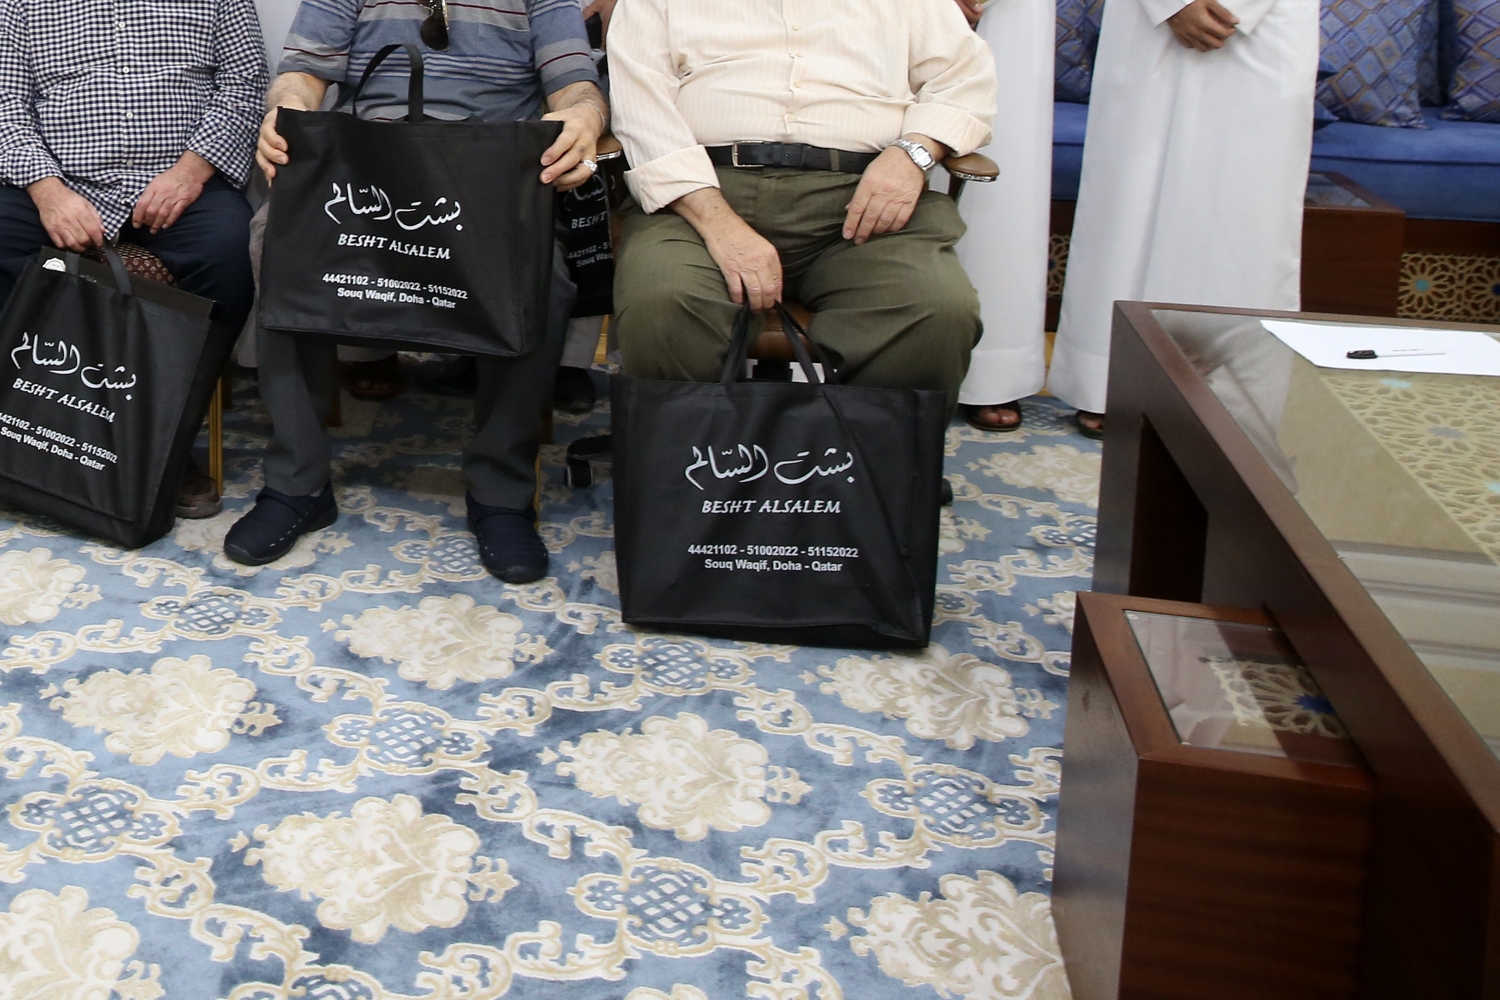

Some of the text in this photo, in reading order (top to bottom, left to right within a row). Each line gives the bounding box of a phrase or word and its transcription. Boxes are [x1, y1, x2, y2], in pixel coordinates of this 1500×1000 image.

[394, 197, 463, 231] بشت
[337, 233, 451, 260] BESHT ALSALEM
[322, 273, 369, 286] 44421102
[376, 277, 421, 291] 51002022
[428, 284, 469, 300] 51152022
[337, 288, 363, 300] Souq
[398, 293, 425, 304] Doha
[431, 297, 456, 309] Qatar
[81, 363, 137, 401] بشت
[12, 378, 116, 423] BESHT ALSALEM
[0, 427, 22, 443] Souq
[51, 445, 74, 460] Doha
[79, 455, 105, 471] Qatar
[35, 426, 76, 447] 51002022
[81, 443, 118, 464] 51152022
[773, 447, 855, 485] بشت
[701, 500, 842, 514] BESHT ALSALEM
[687, 544, 737, 556] 44421102
[746, 545, 798, 557] 51002022
[807, 546, 859, 558] 51152022
[704, 559, 733, 571] Souq
[735, 559, 771, 573] Waqif,
[772, 560, 802, 571] Doha
[811, 561, 843, 572] Qatar
